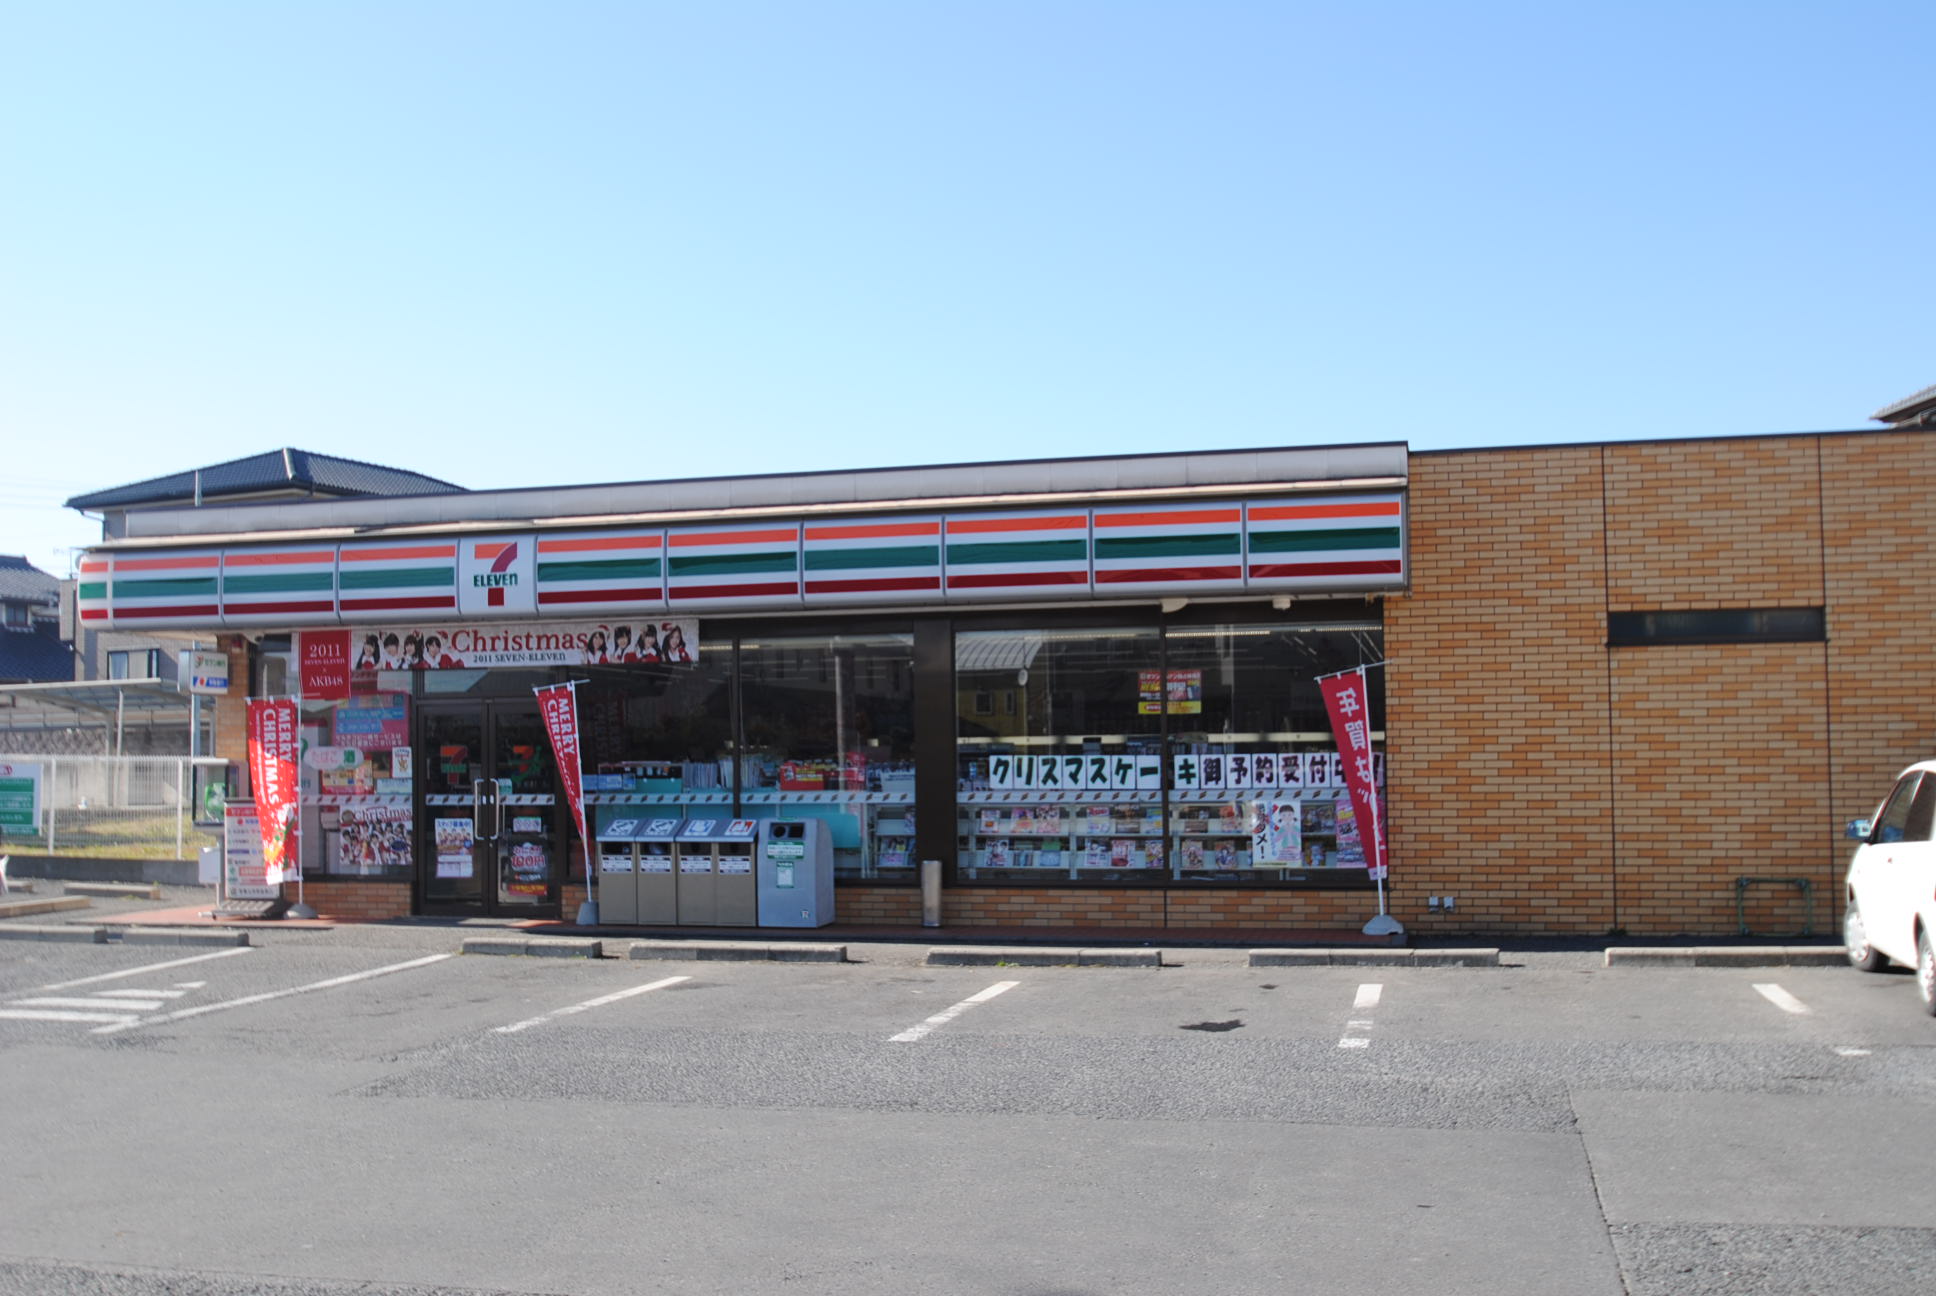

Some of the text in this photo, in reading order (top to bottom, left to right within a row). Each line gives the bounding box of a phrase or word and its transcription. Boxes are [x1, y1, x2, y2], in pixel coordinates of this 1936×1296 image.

[309, 643, 341, 658] 2011
[451, 629, 588, 652] Christmas
[473, 654, 492, 663] 2011
[309, 675, 344, 687] AKB48
[279, 708, 292, 762] MERRY
[558, 698, 576, 755] MERRY
[263, 708, 280, 805] CHRISTMAS
